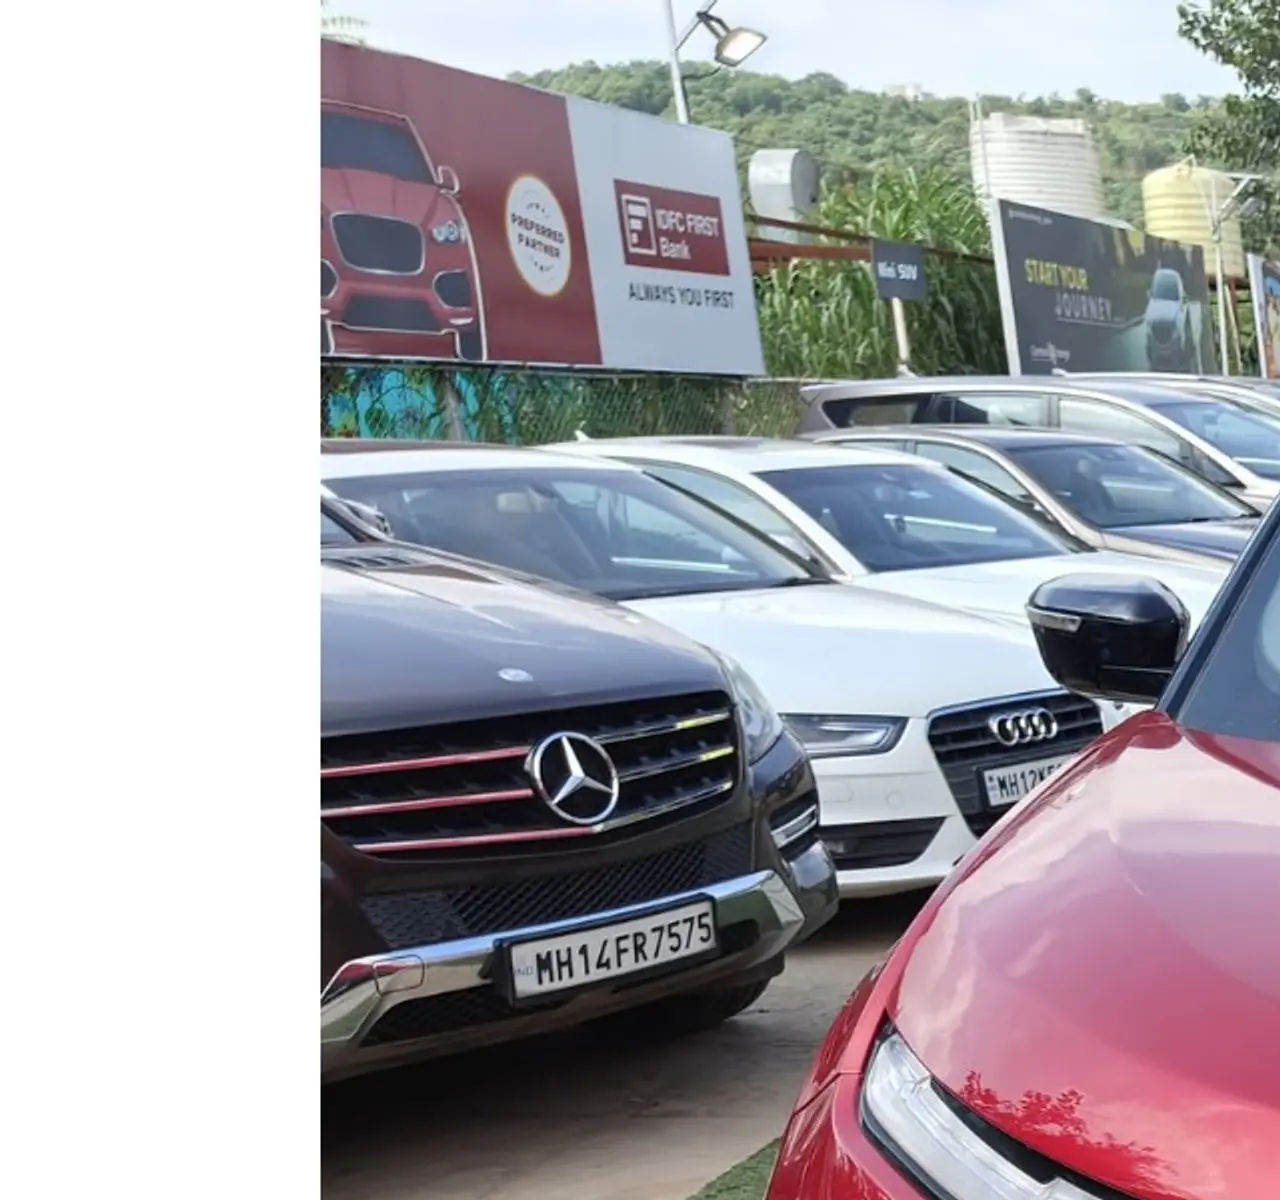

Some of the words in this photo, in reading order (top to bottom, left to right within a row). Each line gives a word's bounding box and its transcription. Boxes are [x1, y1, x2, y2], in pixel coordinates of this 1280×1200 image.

[511, 212, 565, 245] PREFERRED
[654, 209, 685, 233] IDFC
[686, 213, 719, 237] FIRST
[517, 233, 560, 259] PARTNER
[658, 236, 691, 260] Bank
[1024, 258, 1060, 288] START
[1059, 264, 1089, 291] YOUR
[628, 281, 676, 304] ALWAYS
[678, 287, 702, 307] YOU
[704, 289, 734, 309] FIRST
[536, 911, 712, 986] MH14FR7575
